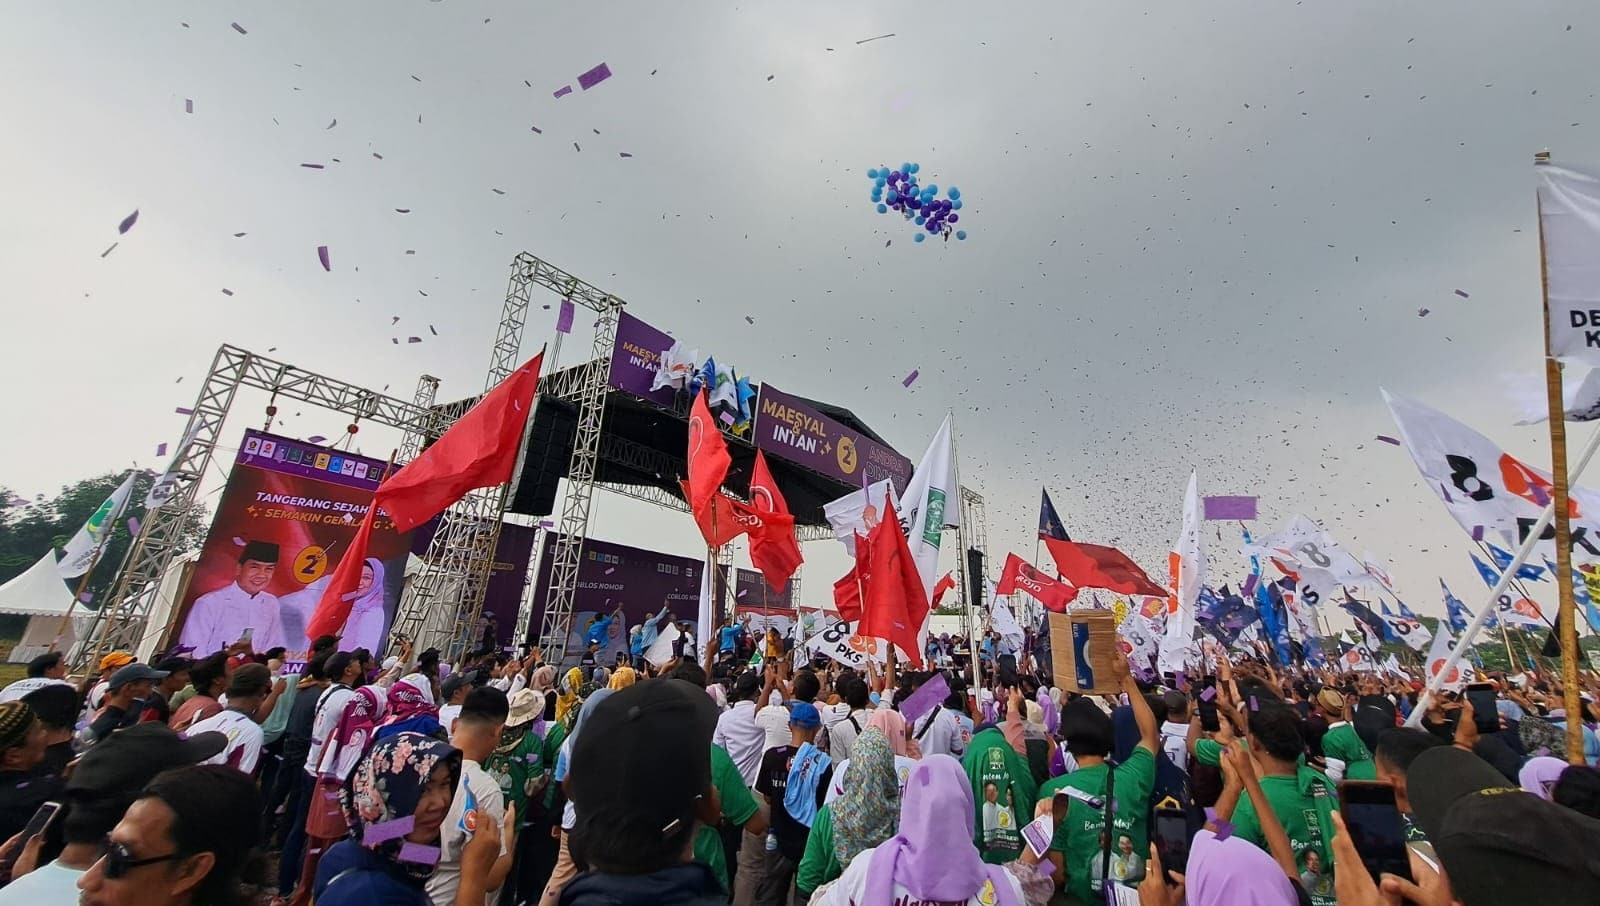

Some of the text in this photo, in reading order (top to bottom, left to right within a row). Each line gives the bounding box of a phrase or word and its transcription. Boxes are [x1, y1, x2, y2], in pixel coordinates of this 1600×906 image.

[762, 398, 827, 438] MAESYAL
[792, 421, 801, 434] &
[773, 425, 816, 453] INTAN
[842, 445, 852, 466] 2
[256, 491, 331, 510] TANGERANG
[265, 508, 321, 523] SEMAKIN
[301, 554, 318, 575] 2
[1301, 542, 1331, 568] 8
[823, 622, 850, 644] 8
[1129, 631, 1145, 646] 8
[835, 642, 863, 663] PKS
[1358, 647, 1371, 662] 8
